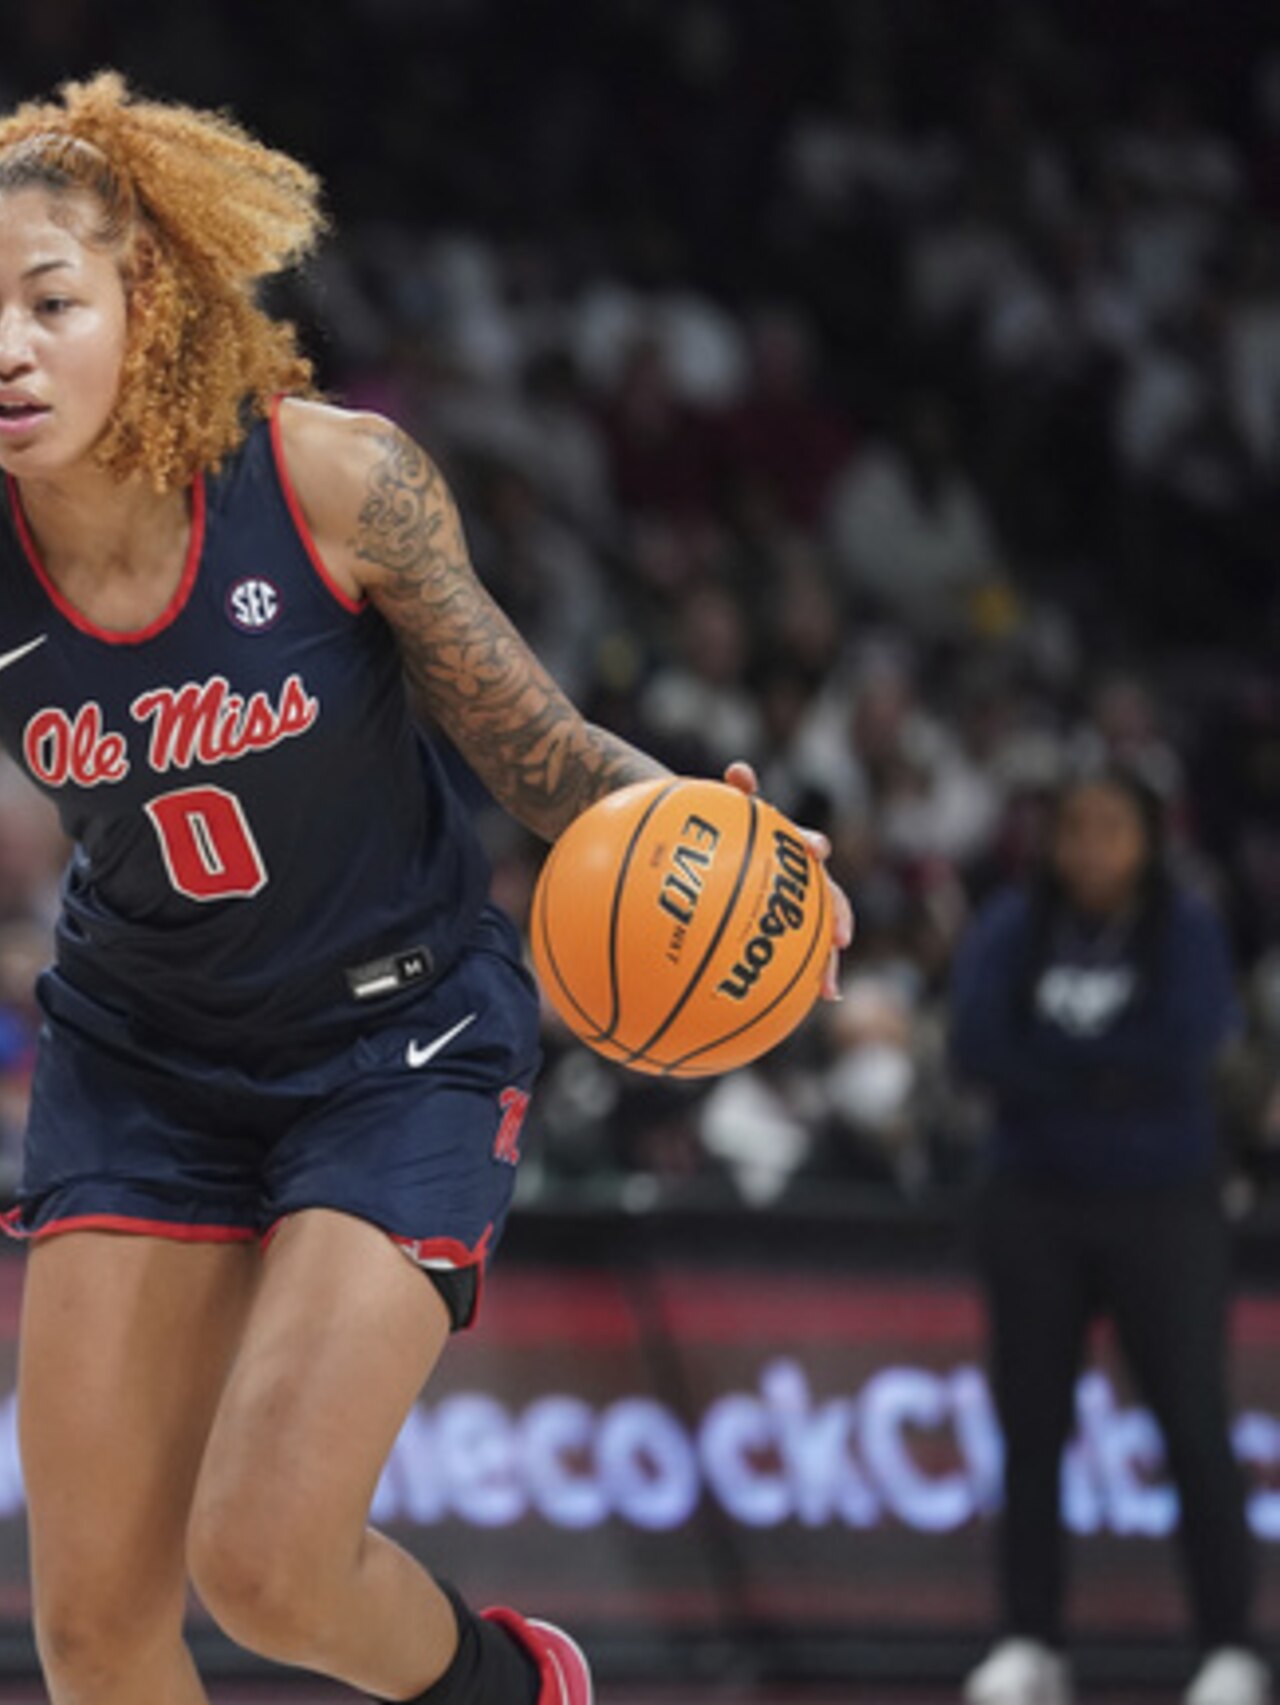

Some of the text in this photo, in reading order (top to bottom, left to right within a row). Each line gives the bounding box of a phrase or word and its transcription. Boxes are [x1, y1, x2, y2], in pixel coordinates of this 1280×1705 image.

[229, 578, 280, 628] SEC
[24, 675, 318, 785] Ole Miss
[144, 785, 268, 901] 0
[717, 829, 810, 1001] Wilson
